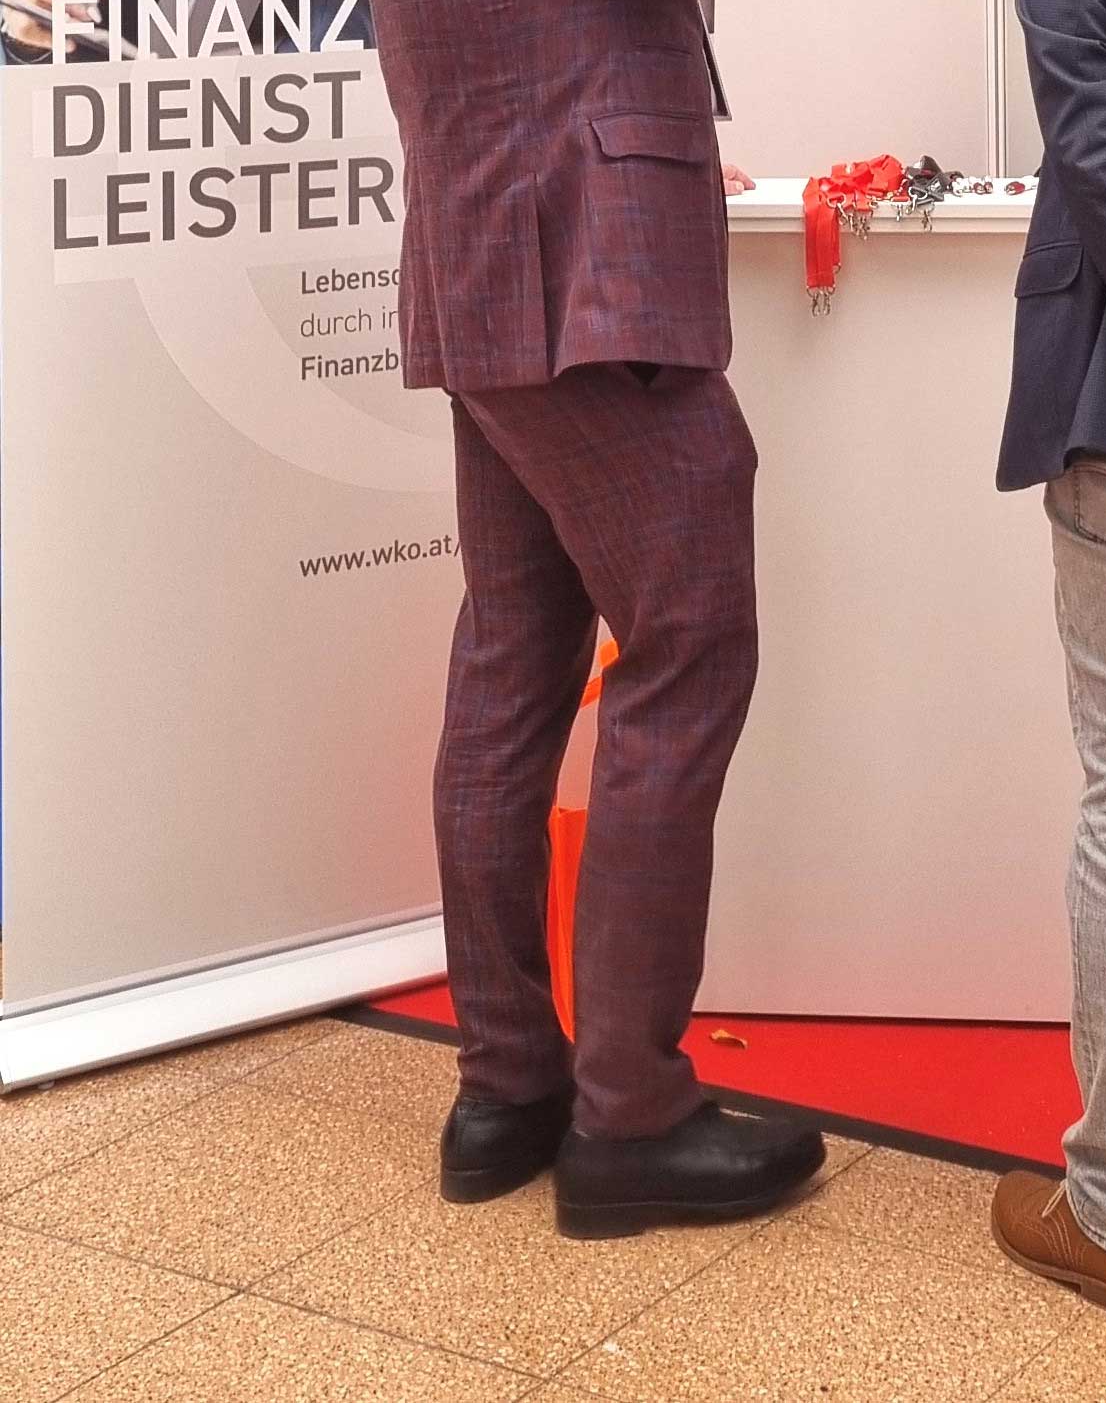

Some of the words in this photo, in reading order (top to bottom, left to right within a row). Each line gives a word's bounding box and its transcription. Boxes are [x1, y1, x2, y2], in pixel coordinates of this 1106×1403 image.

[53, 70, 361, 158] DIENST
[53, 156, 396, 250] LEISTER
[300, 308, 372, 338] durch
